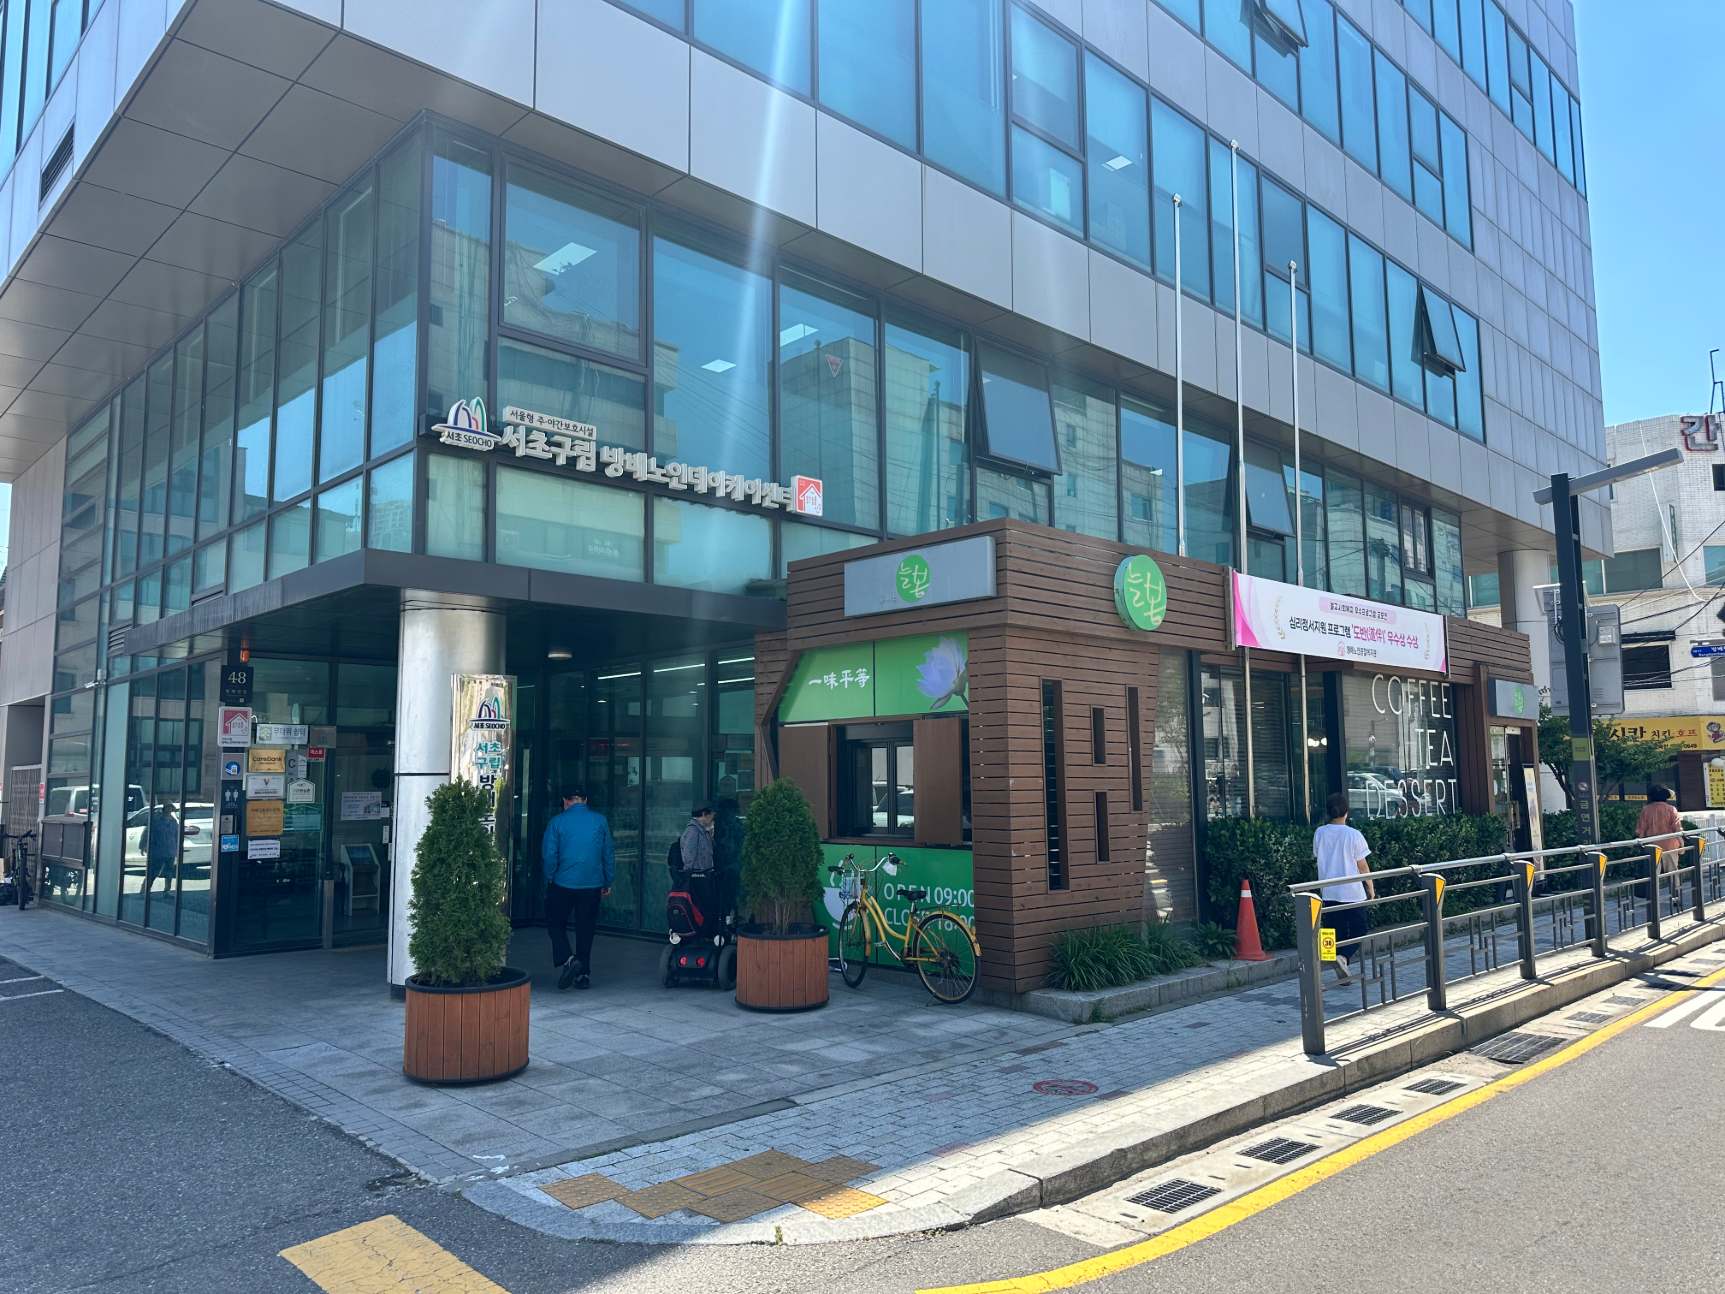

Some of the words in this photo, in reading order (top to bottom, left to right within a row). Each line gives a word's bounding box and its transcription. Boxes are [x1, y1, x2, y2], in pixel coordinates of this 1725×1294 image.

[510, 410, 534, 424] 서울형
[446, 431, 462, 442] 서초
[463, 432, 492, 448] SEOCHO
[501, 425, 597, 473] 서초구립
[600, 445, 795, 513] 방배노인데이케어센터
[1289, 615, 1328, 635] 심리정서지원
[1327, 622, 1352, 639] 프로그램
[1387, 631, 1406, 647] 우수상
[1406, 634, 1419, 649] 수상
[228, 671, 247, 684] 48
[808, 667, 871, 689] 一味平等
[1371, 673, 1452, 719] COFFEE
[476, 742, 501, 754] 서초
[1414, 728, 1454, 767] TEA
[475, 757, 501, 769] 구립
[1365, 778, 1457, 820] DESSERT
[934, 887, 975, 907] 09:00
